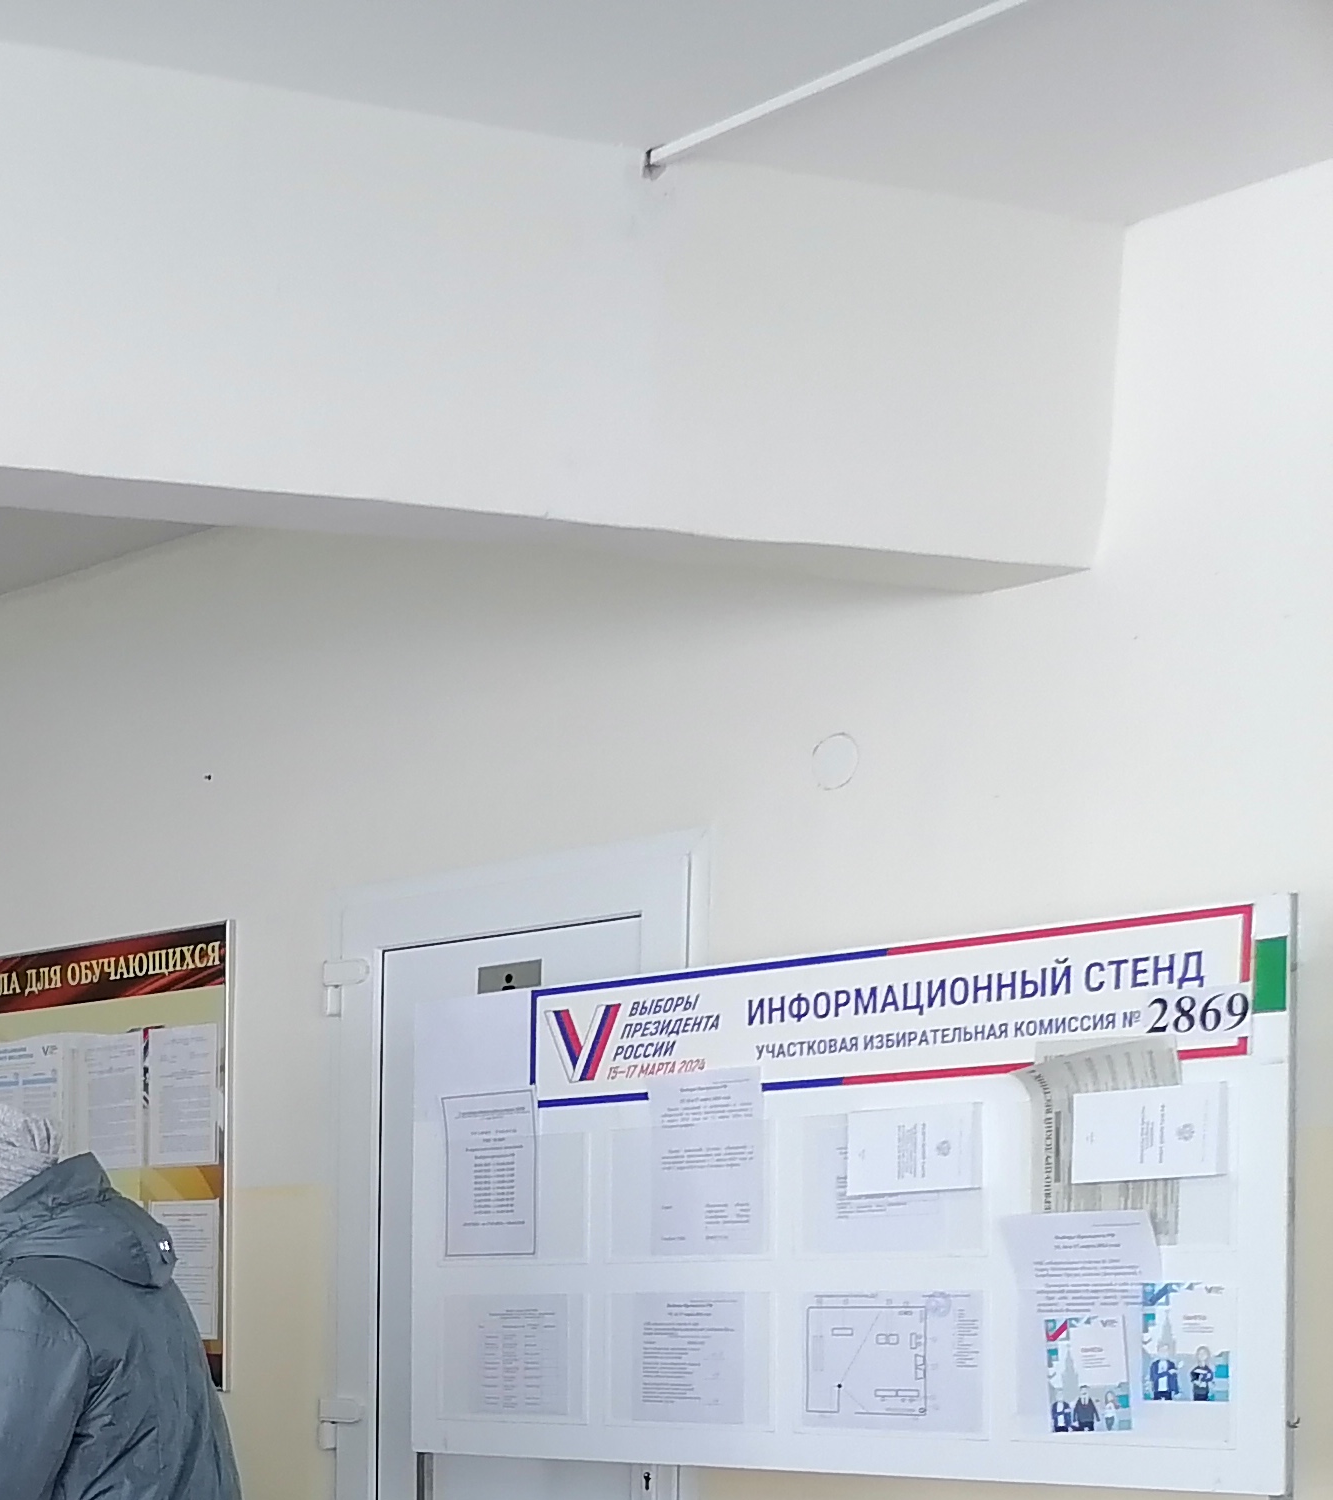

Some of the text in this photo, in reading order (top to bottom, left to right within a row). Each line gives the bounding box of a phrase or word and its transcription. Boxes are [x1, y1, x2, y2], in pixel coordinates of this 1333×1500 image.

[24, 965, 62, 996] ДЛЯ
[66, 941, 221, 986] ОБУЧАЮЩИХСЯ
[747, 950, 1205, 1026] ИНФОРМАЦИОННЫЙ СТЕНД
[628, 993, 701, 1018] ВЫБОРЫ
[620, 1013, 721, 1040] ПРЕЗИДЕНТА
[755, 1036, 859, 1061] УЧАСТКОВАЯ
[863, 1022, 1009, 1051] ИЗБИРАТЕЛЬНАЯ
[1013, 1012, 1116, 1038] КОМИССИЯ
[1145, 992, 1250, 1034] 2869
[612, 1040, 677, 1062] РОССИИ
[637, 1060, 676, 1078] МАРТА
[677, 1058, 706, 1074] 2024
